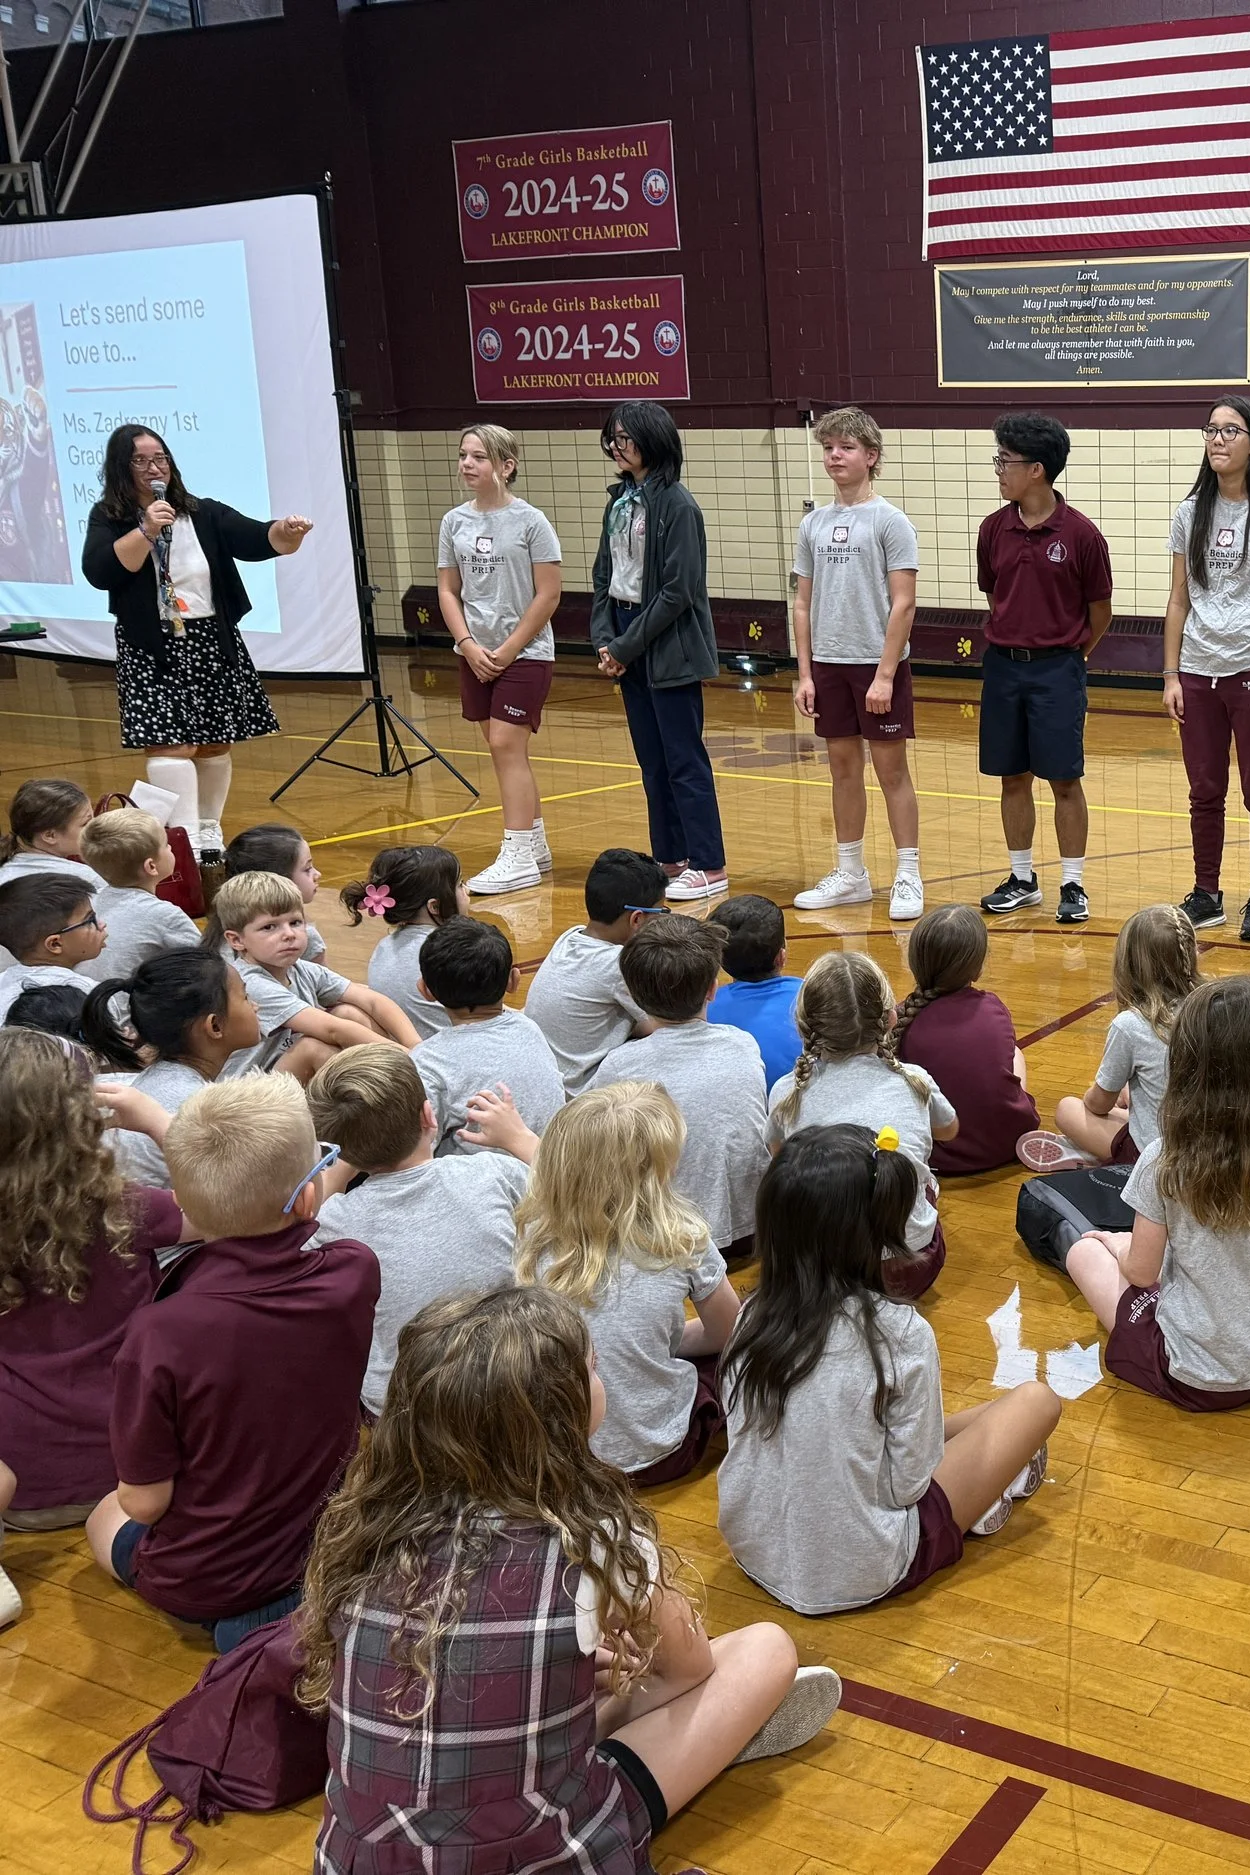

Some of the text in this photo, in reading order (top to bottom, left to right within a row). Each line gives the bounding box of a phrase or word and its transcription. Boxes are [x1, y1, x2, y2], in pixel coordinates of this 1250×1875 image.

[476, 140, 649, 171] 7th Grade Girls Basketball
[501, 172, 629, 217] 2024-25
[491, 222, 649, 247] LAKEFRONT CHAMPION
[1077, 270, 1100, 281] Lord,
[952, 286, 970, 298] May
[976, 287, 1010, 297] compete
[1011, 285, 1029, 294] with
[1031, 285, 1059, 296] respect
[1060, 283, 1074, 295] for
[1075, 284, 1089, 294] my
[1091, 281, 1136, 292] teammates
[1138, 280, 1155, 290] and
[1154, 279, 1169, 292] for
[1171, 281, 1185, 292] my
[1187, 278, 1234, 291] opponents.
[59, 296, 205, 327] Let's send some
[489, 293, 660, 315] 8th Grade Girls Basketball
[1023, 295, 1156, 310] May I push myself to do my best.
[973, 315, 992, 325] Give
[1007, 314, 1019, 323] the
[1021, 314, 1057, 325] strength,
[1058, 312, 1104, 323] endurance,
[1106, 311, 1127, 322] skills
[1128, 310, 1145, 321] and
[1147, 309, 1210, 322] sportsmanship
[1031, 326, 1039, 334] to
[1040, 324, 1050, 334] be
[1051, 324, 1065, 334] the
[1066, 324, 1083, 333] best
[1084, 323, 1112, 333] athlete
[1136, 322, 1149, 332] be.
[514, 322, 641, 361] 2024-25
[987, 340, 1004, 350] And
[1005, 339, 1016, 349] let
[1031, 339, 1060, 350] always
[1062, 338, 1104, 348] remember
[1105, 338, 1122, 347] that
[1124, 337, 1143, 347] with
[1142, 337, 1164, 349] faith
[1167, 337, 1175, 346] in
[1177, 339, 1195, 348] you,
[64, 341, 137, 365] love to...
[1045, 349, 1135, 361] all things are possible.
[1076, 365, 1103, 374] Amen.
[503, 371, 660, 389] LAKEFRONT CHAMPION
[63, 412, 91, 434] Ms.
[172, 410, 200, 431] 1st
[68, 444, 104, 466] Grad
[1210, 549, 1244, 558] Benedic
[1209, 561, 1234, 569] PREP
